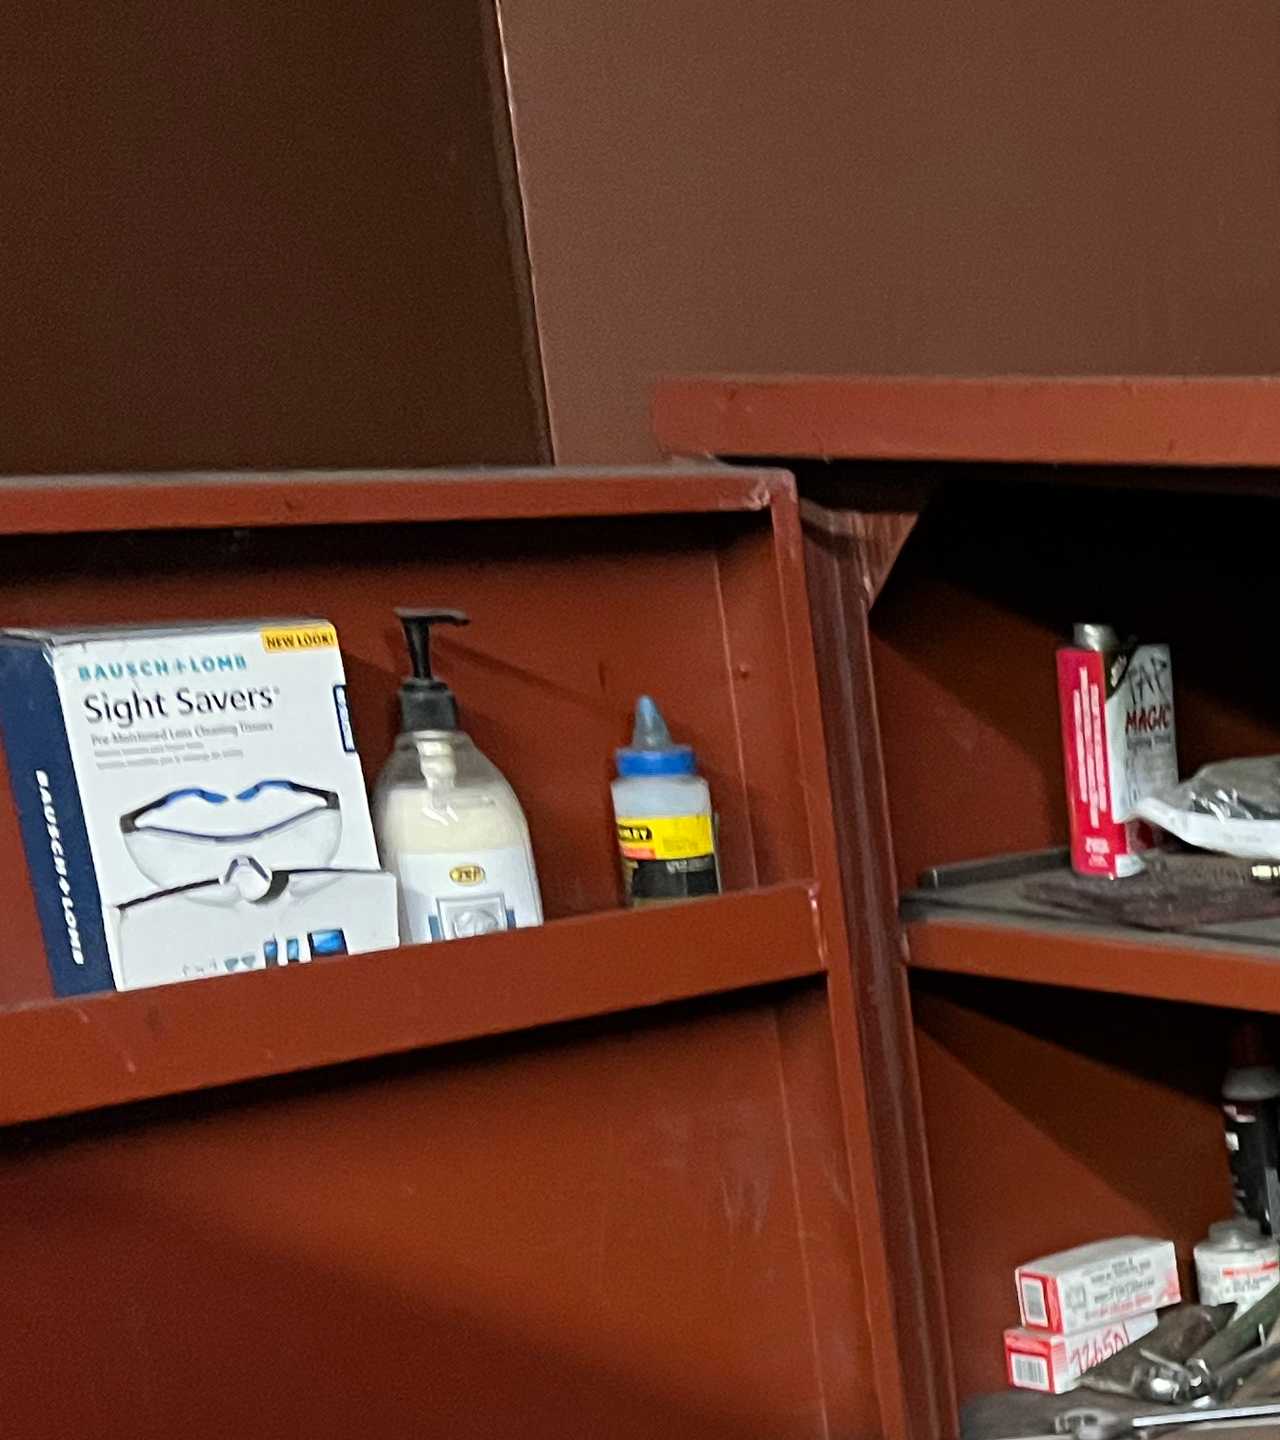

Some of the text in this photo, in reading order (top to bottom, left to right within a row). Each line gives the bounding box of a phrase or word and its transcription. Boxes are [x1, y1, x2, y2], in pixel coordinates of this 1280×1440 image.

[267, 630, 335, 649] NEW LOOK!
[84, 685, 274, 728] Sight Savers
[1125, 704, 1172, 736] MAGIC
